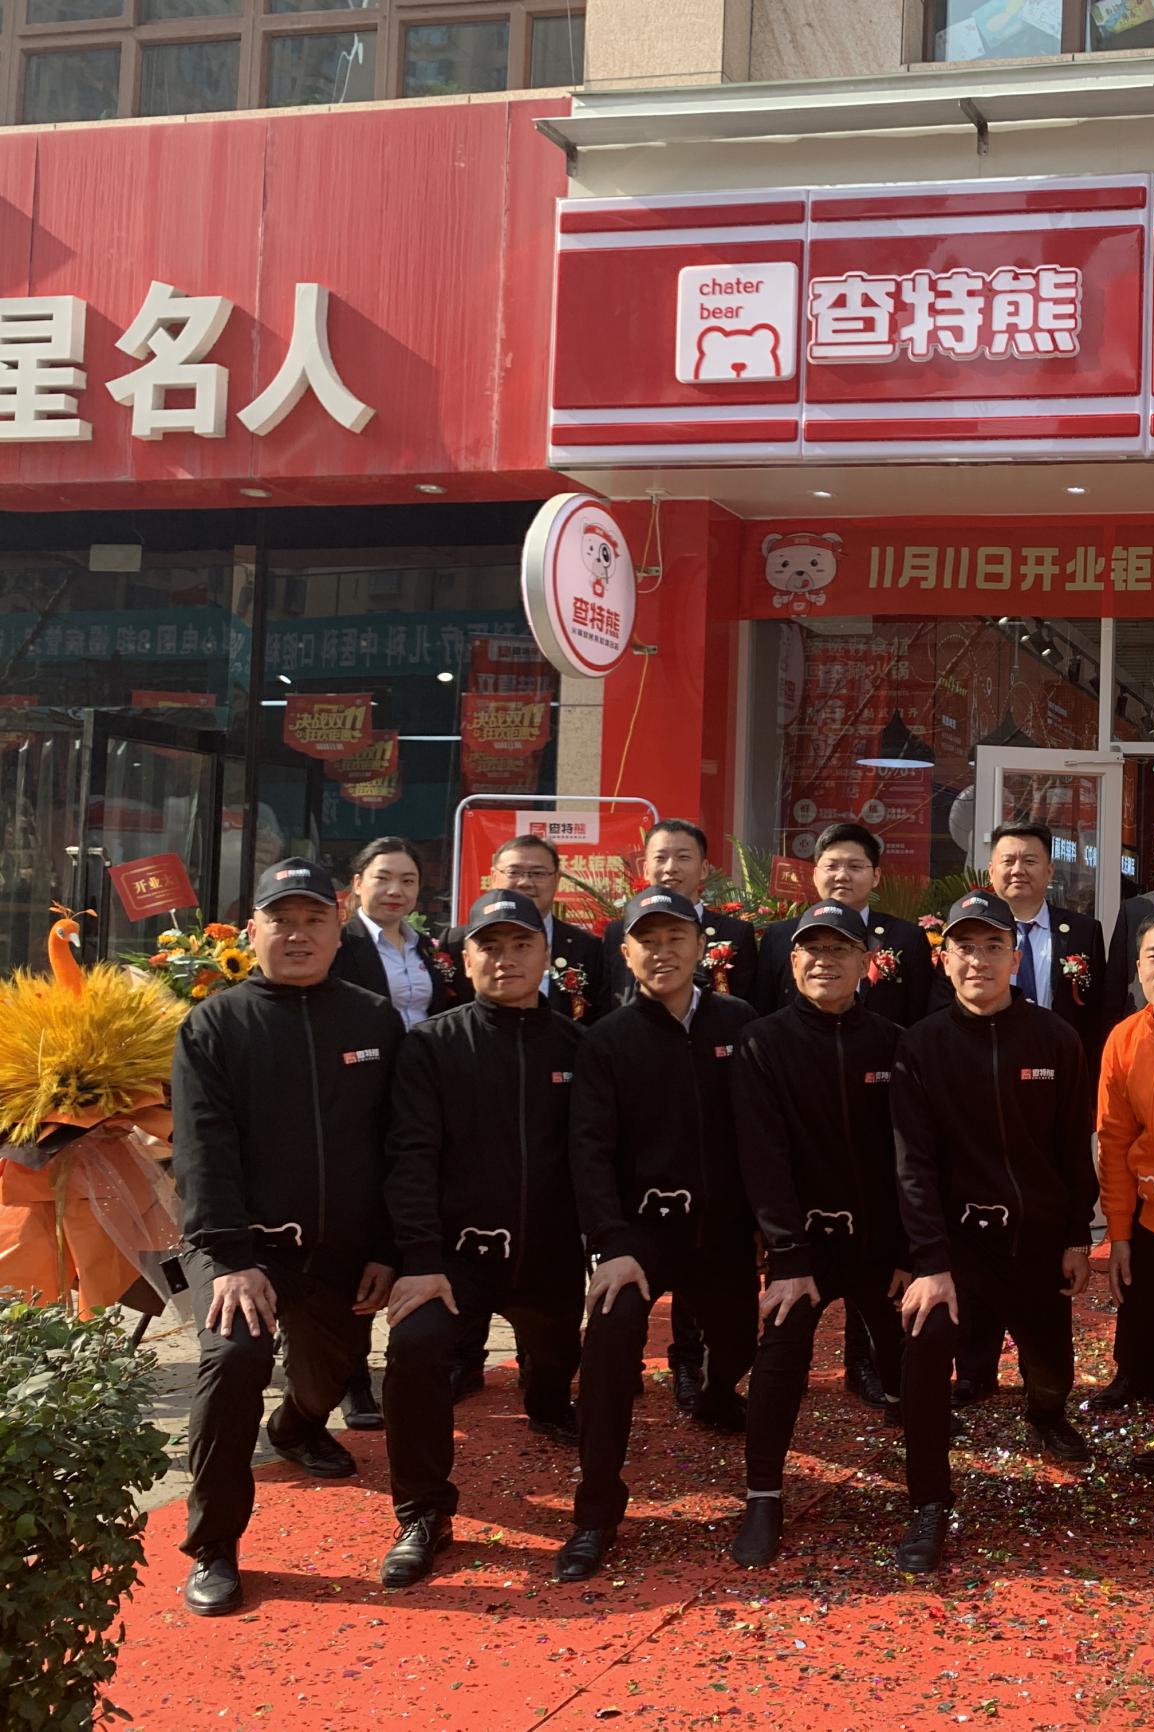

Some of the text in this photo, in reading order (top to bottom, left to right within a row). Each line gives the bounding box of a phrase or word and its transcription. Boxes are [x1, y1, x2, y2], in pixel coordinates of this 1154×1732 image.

[699, 277, 764, 296] chater
[699, 302, 743, 320] bear
[809, 266, 1081, 362] 查特熊
[0, 281, 376, 441] 星名人
[572, 596, 621, 639] 查特熊
[548, 822, 587, 834] 查特熊
